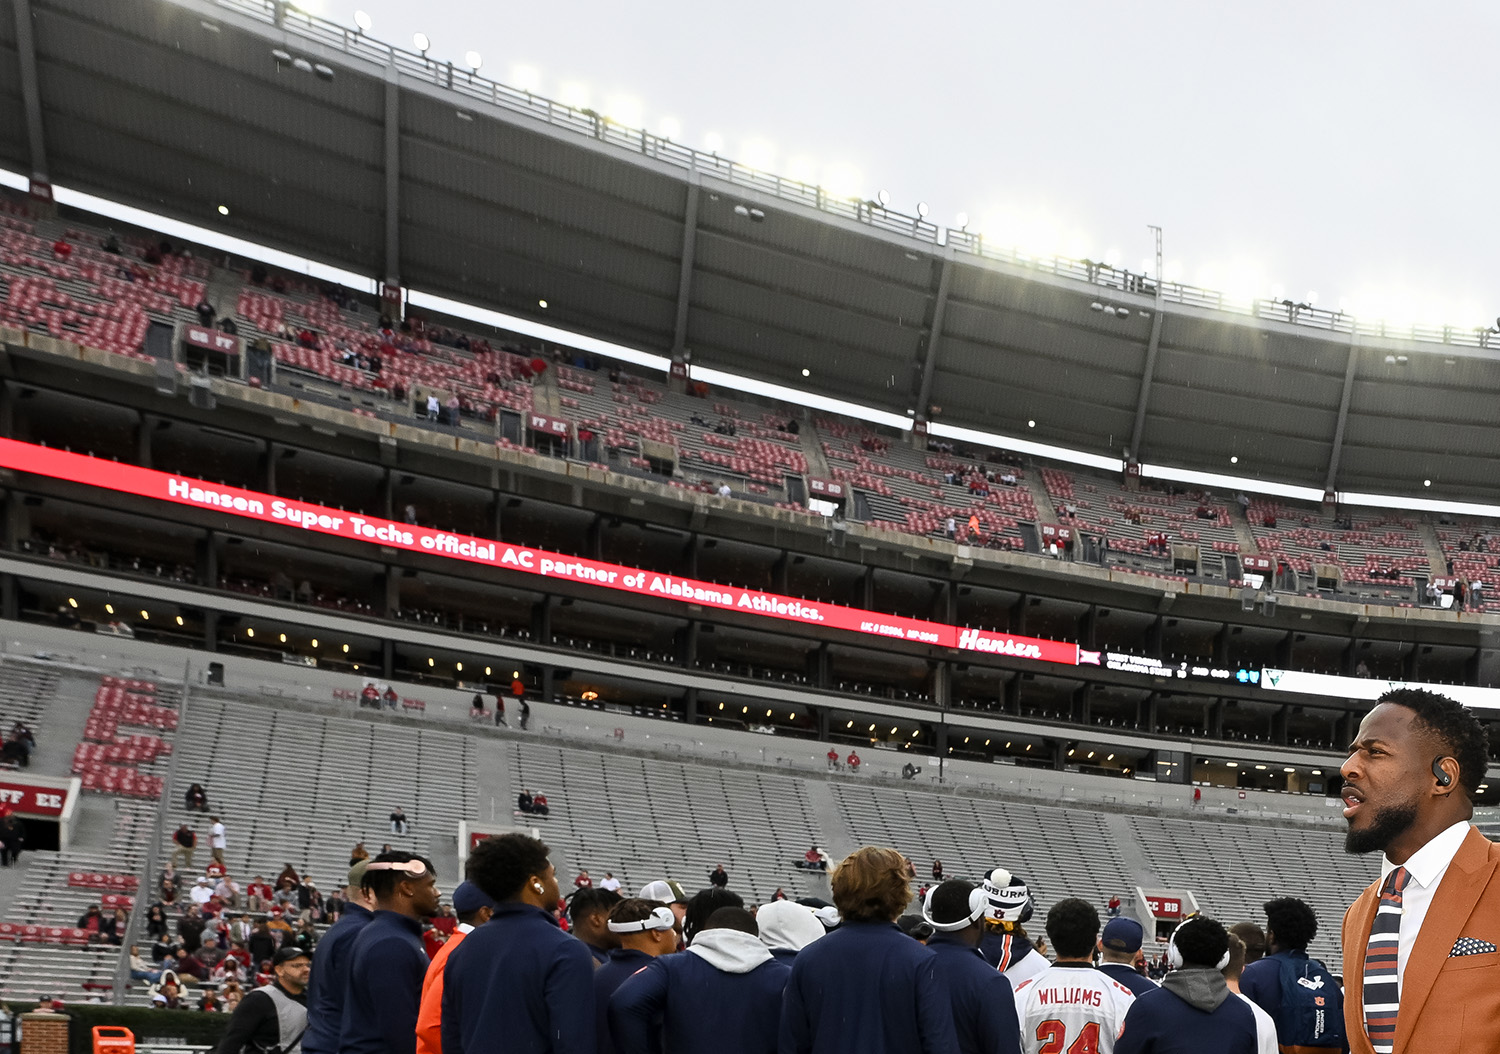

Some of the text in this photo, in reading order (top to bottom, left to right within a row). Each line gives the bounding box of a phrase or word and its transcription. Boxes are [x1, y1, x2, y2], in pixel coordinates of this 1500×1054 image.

[1059, 529, 1070, 538] CC
[168, 478, 825, 622] Hansen Super Techs official AC partner of Alabama Athletics.
[958, 628, 1042, 658] Hansen
[0, 789, 62, 808] FF EE
[984, 885, 1027, 898] UBURN
[1164, 902, 1178, 912] BB
[1038, 986, 1102, 1007] WILLIAMS
